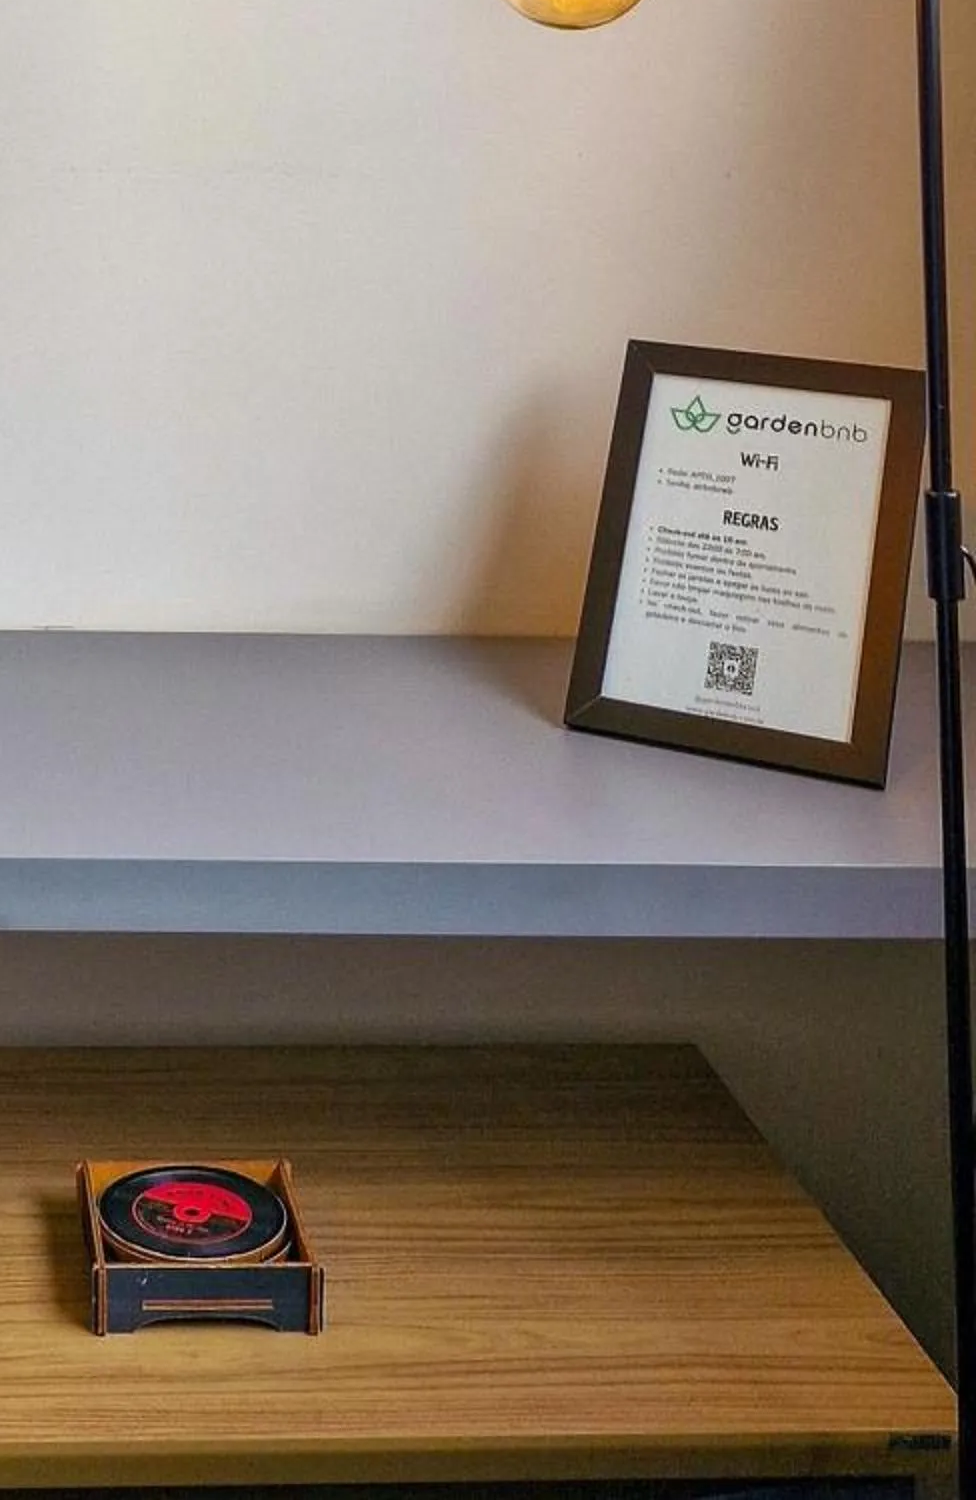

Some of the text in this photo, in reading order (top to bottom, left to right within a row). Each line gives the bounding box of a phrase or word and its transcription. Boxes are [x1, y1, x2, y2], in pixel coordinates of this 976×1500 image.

[726, 413, 868, 443] gardenbnb
[740, 451, 779, 471] Wi-Fi
[723, 509, 779, 532] REGRAS
